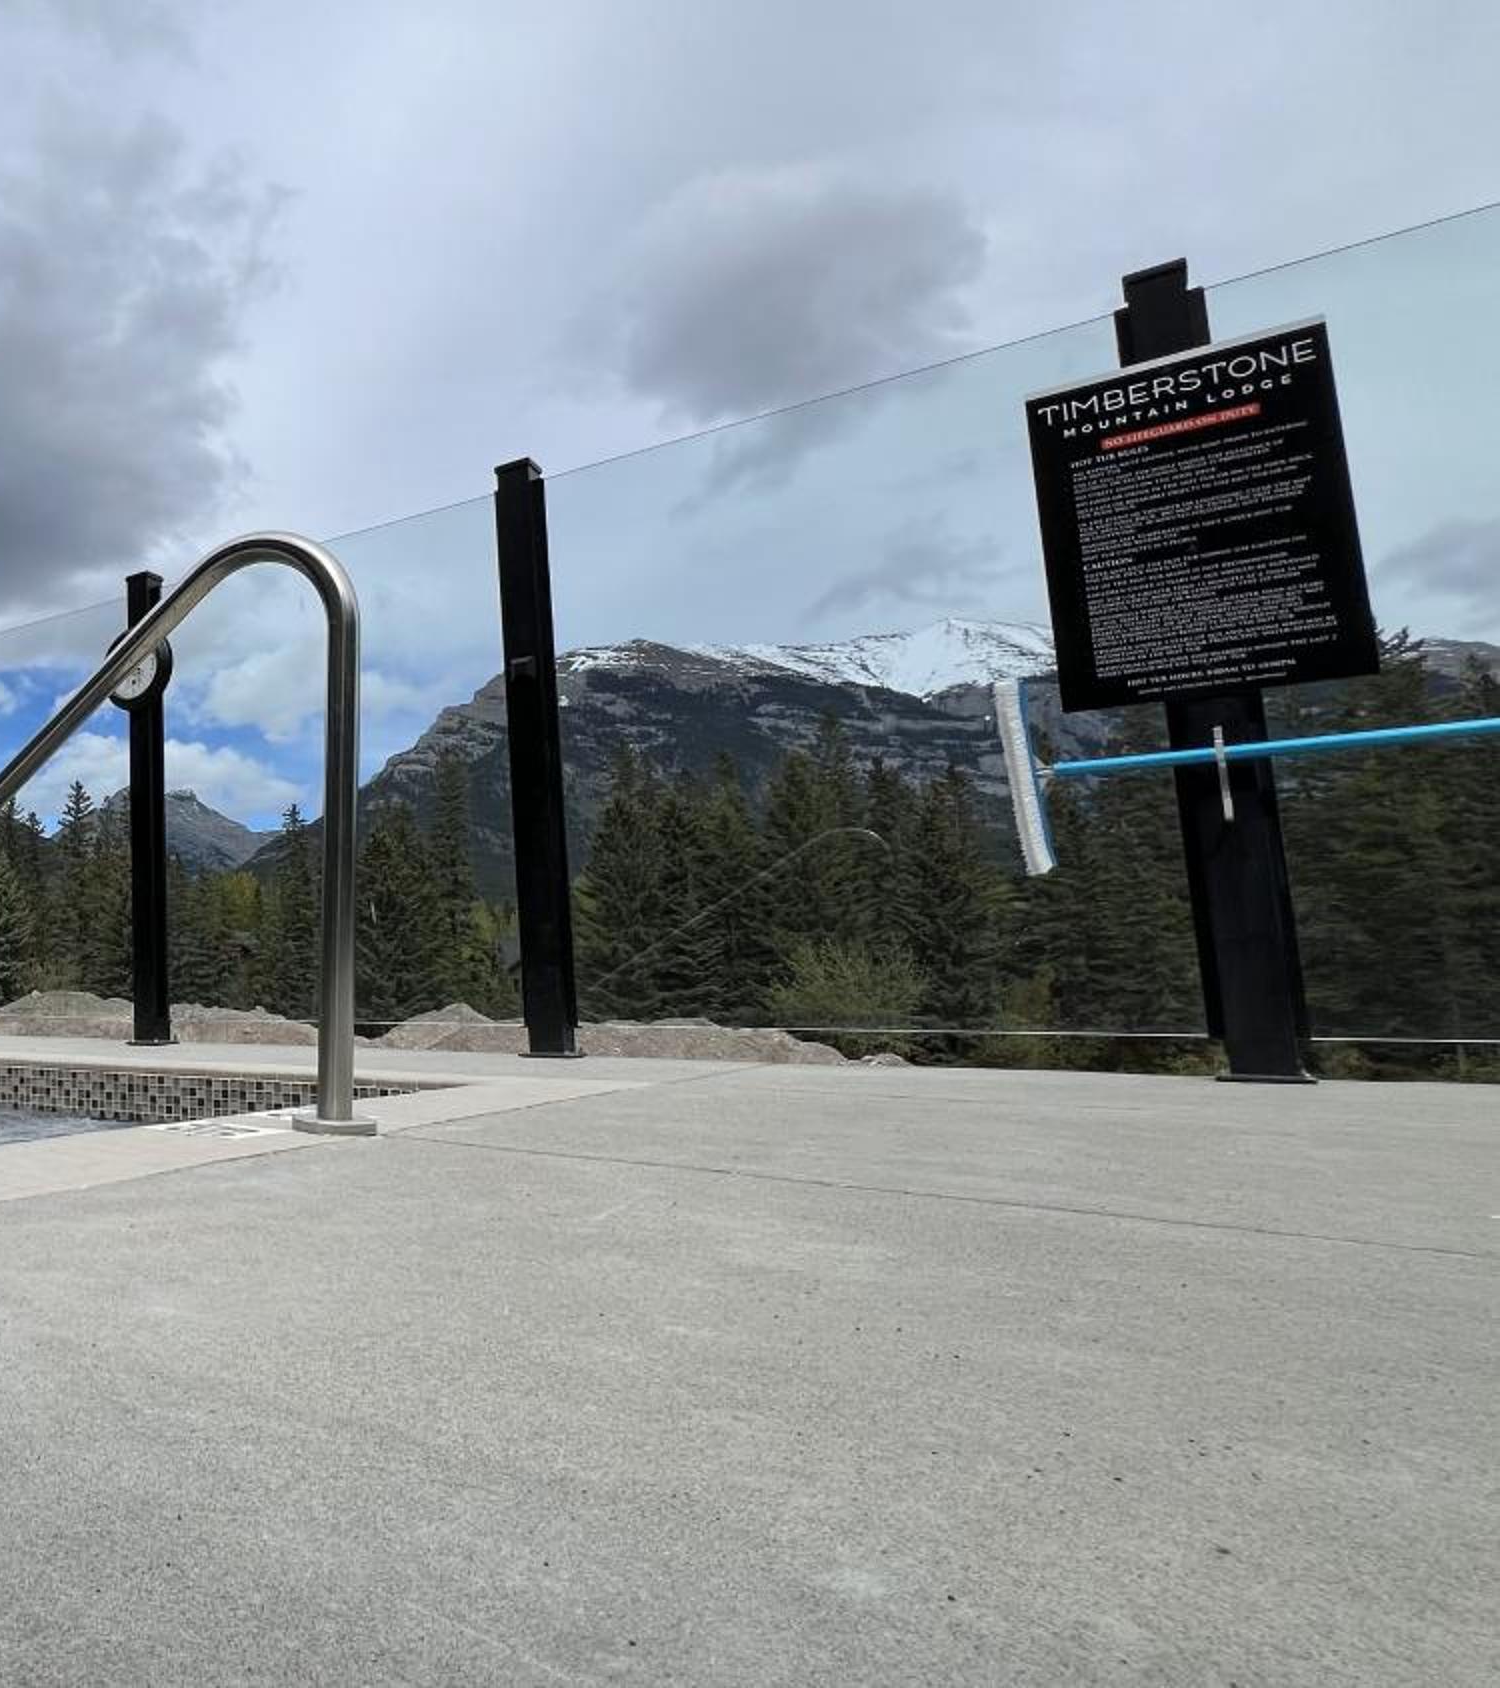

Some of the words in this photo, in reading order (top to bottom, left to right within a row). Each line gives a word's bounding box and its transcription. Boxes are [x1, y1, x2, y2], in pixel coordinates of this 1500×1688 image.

[1037, 339, 1317, 426] TIMBERSTONE
[1063, 401, 1188, 438] MOUNTAIN
[1206, 373, 1293, 403] LODGE
[1104, 436, 1123, 448] NO
[1127, 421, 1195, 443] LIFEGUARD
[1219, 406, 1255, 421] DUTY
